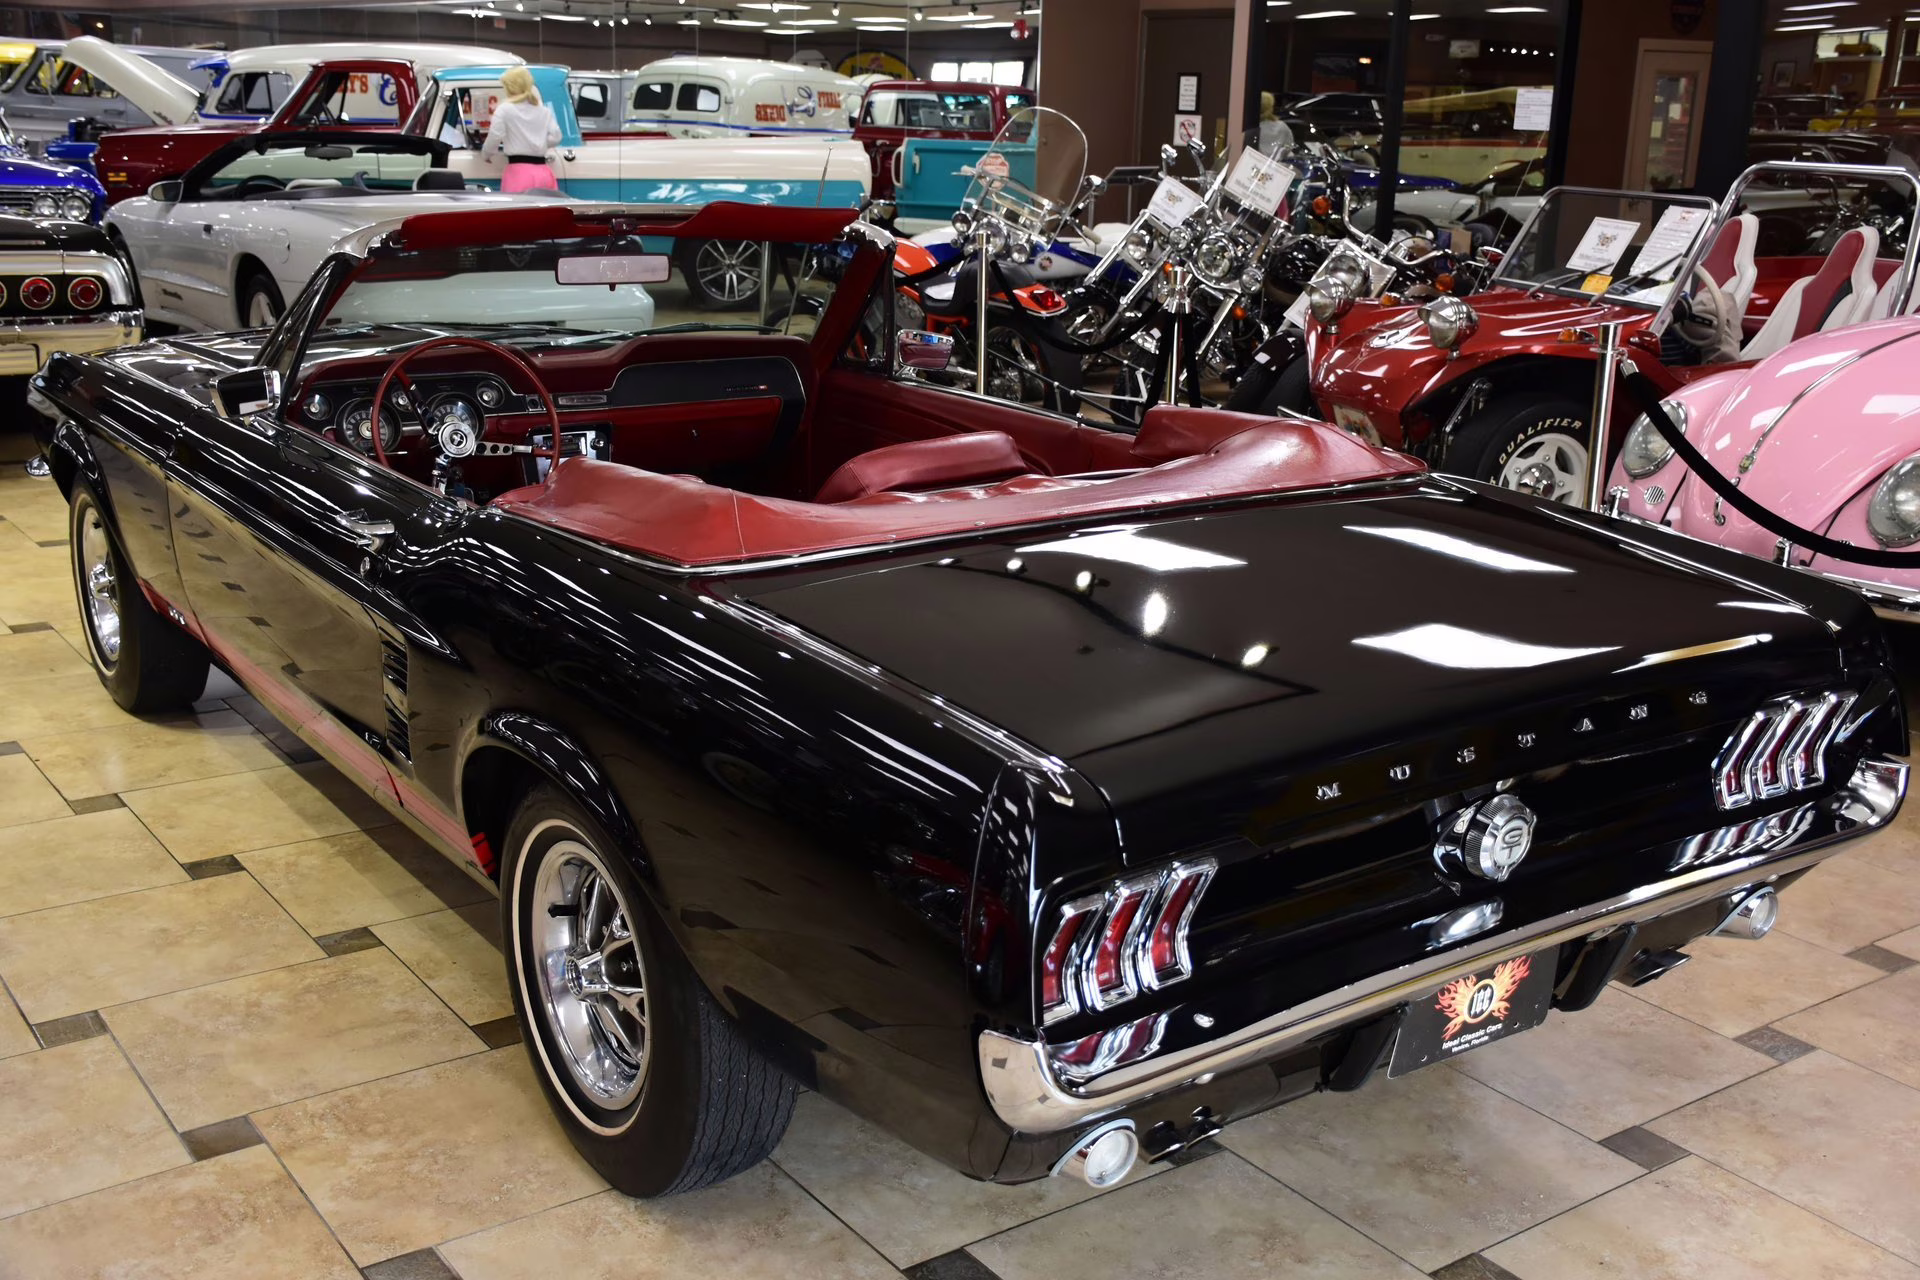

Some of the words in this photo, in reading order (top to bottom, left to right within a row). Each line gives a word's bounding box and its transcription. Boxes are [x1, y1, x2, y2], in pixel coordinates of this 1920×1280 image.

[1498, 417, 1583, 465] QUALIFIER
[1316, 691, 1708, 800] MUSTANG
[1501, 825, 1523, 860] GT
[1442, 1037, 1460, 1050] Ideal
[1460, 1029, 1485, 1043] Classic
[1486, 1023, 1502, 1033] Cars
